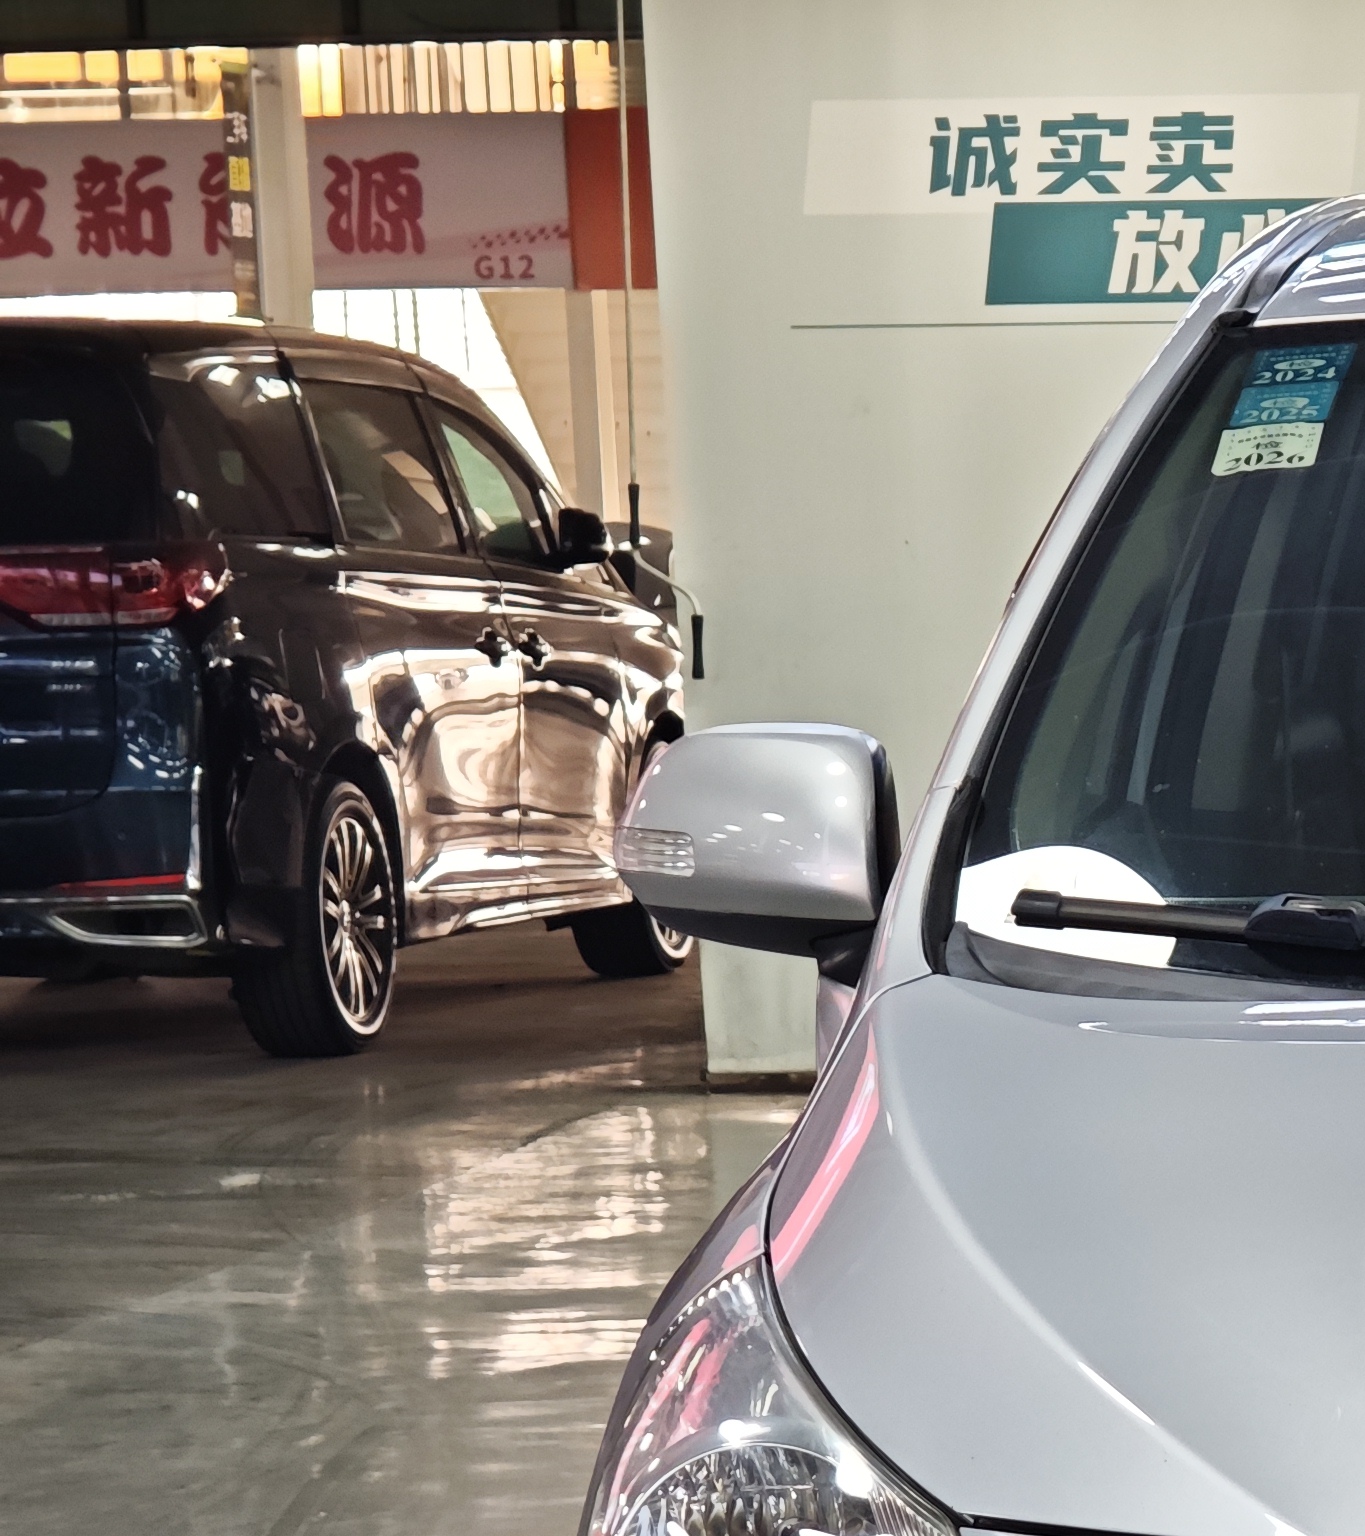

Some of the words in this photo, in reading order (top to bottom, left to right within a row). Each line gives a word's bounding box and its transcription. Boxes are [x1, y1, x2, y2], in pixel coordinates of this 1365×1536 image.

[928, 112, 1235, 197] 诚实卖
[474, 255, 535, 280] G12
[1252, 366, 1336, 385] 2024
[1239, 405, 1321, 424] 2025
[1223, 450, 1309, 472] 2026
